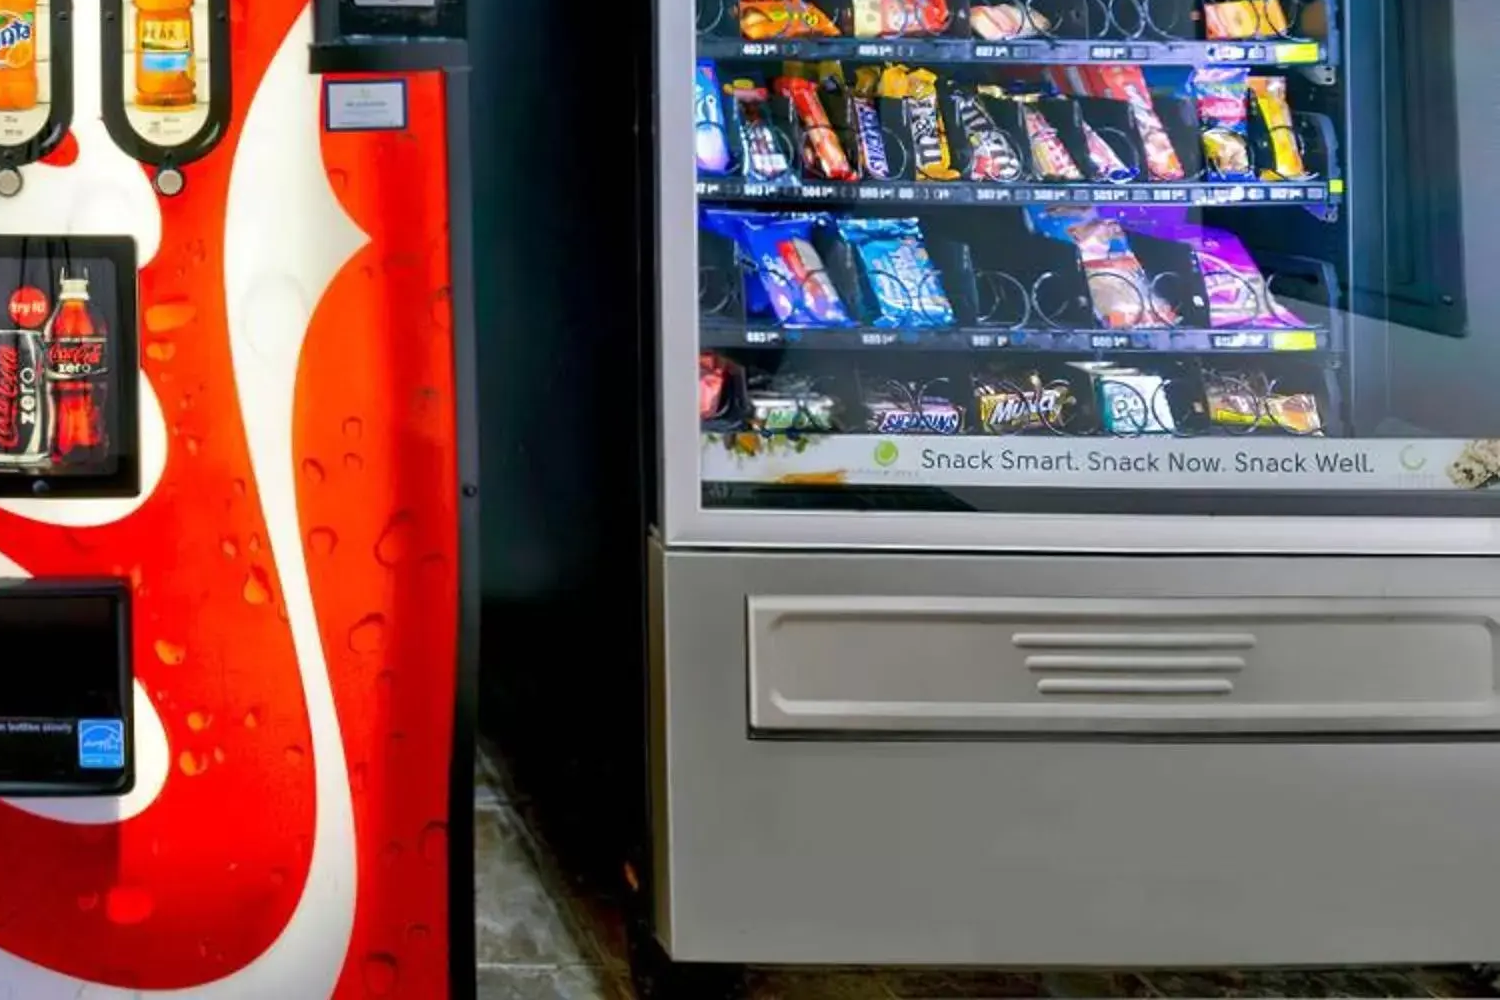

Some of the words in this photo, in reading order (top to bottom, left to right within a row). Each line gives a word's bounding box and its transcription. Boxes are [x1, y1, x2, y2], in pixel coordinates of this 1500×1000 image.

[57, 363, 91, 373] zero
[20, 367, 35, 425] zero
[922, 449, 993, 469] Snack
[1001, 450, 1079, 471] Smart.
[1088, 452, 1159, 472] Snack
[1169, 453, 1226, 473] Now.
[1235, 452, 1307, 473] Snack
[1316, 453, 1374, 473] Well.
